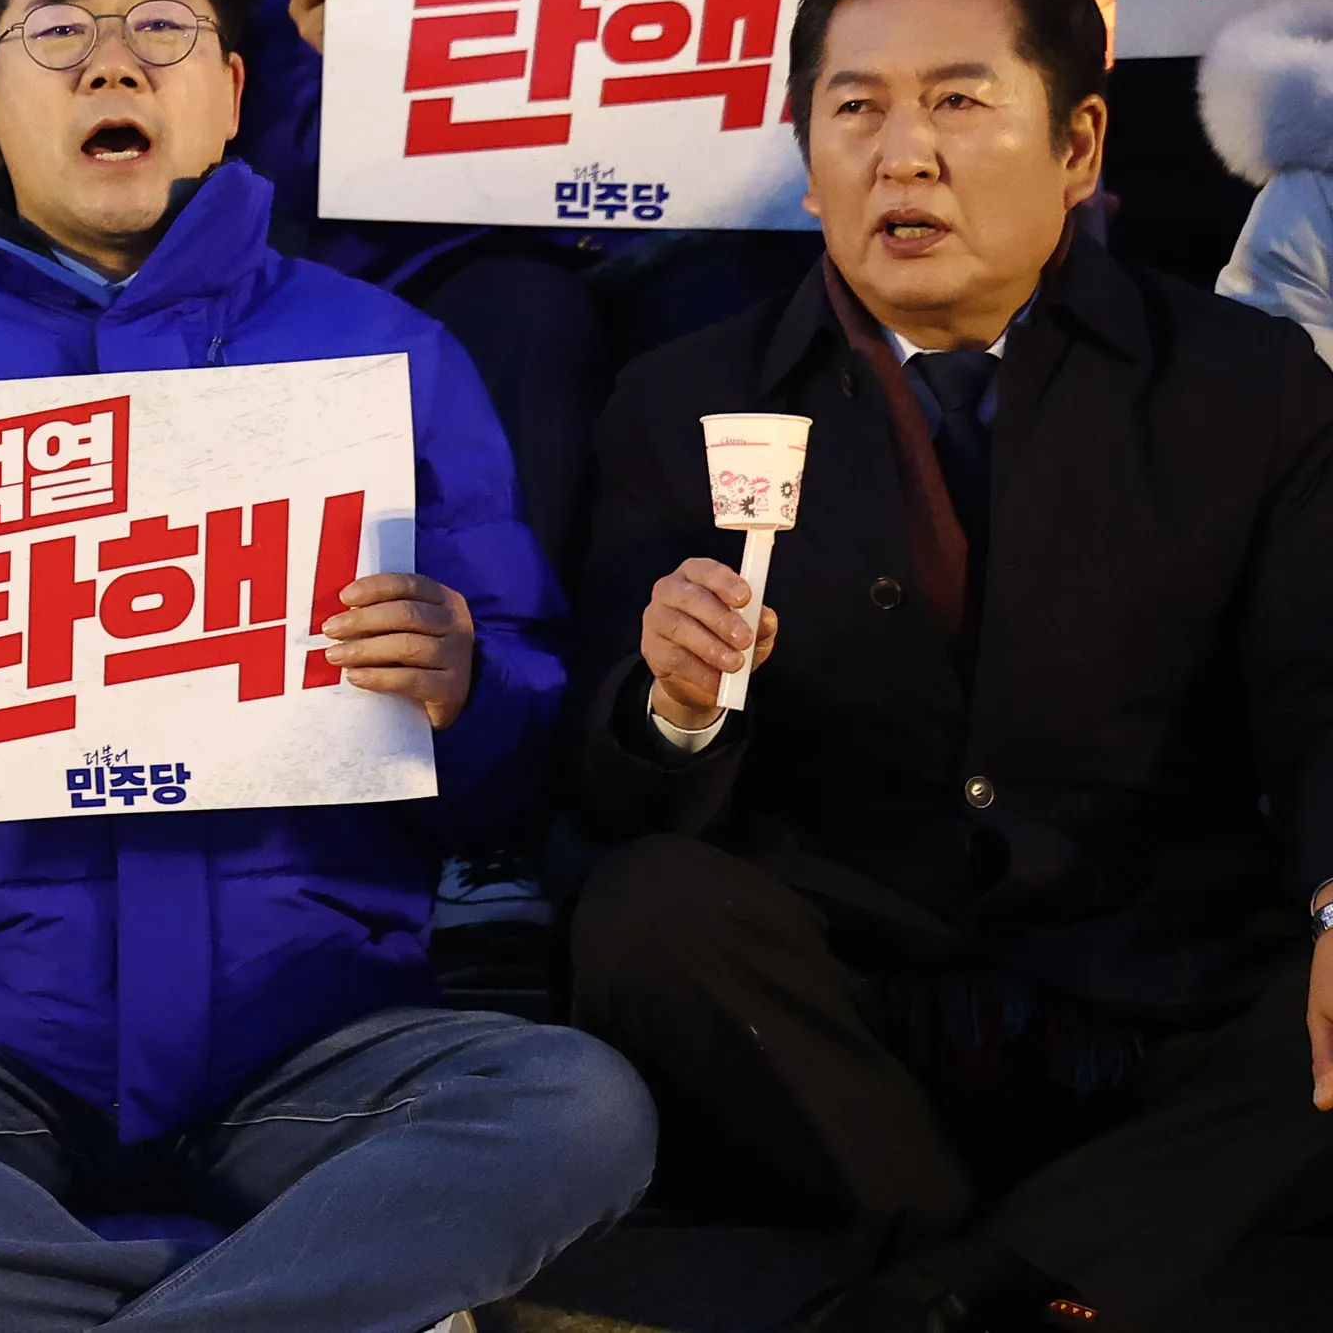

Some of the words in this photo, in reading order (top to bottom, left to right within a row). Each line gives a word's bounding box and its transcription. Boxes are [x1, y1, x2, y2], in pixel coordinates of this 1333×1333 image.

[555, 182, 670, 221] 민주당
[83, 744, 129, 768] 더불어
[66, 762, 192, 809] 민주당
